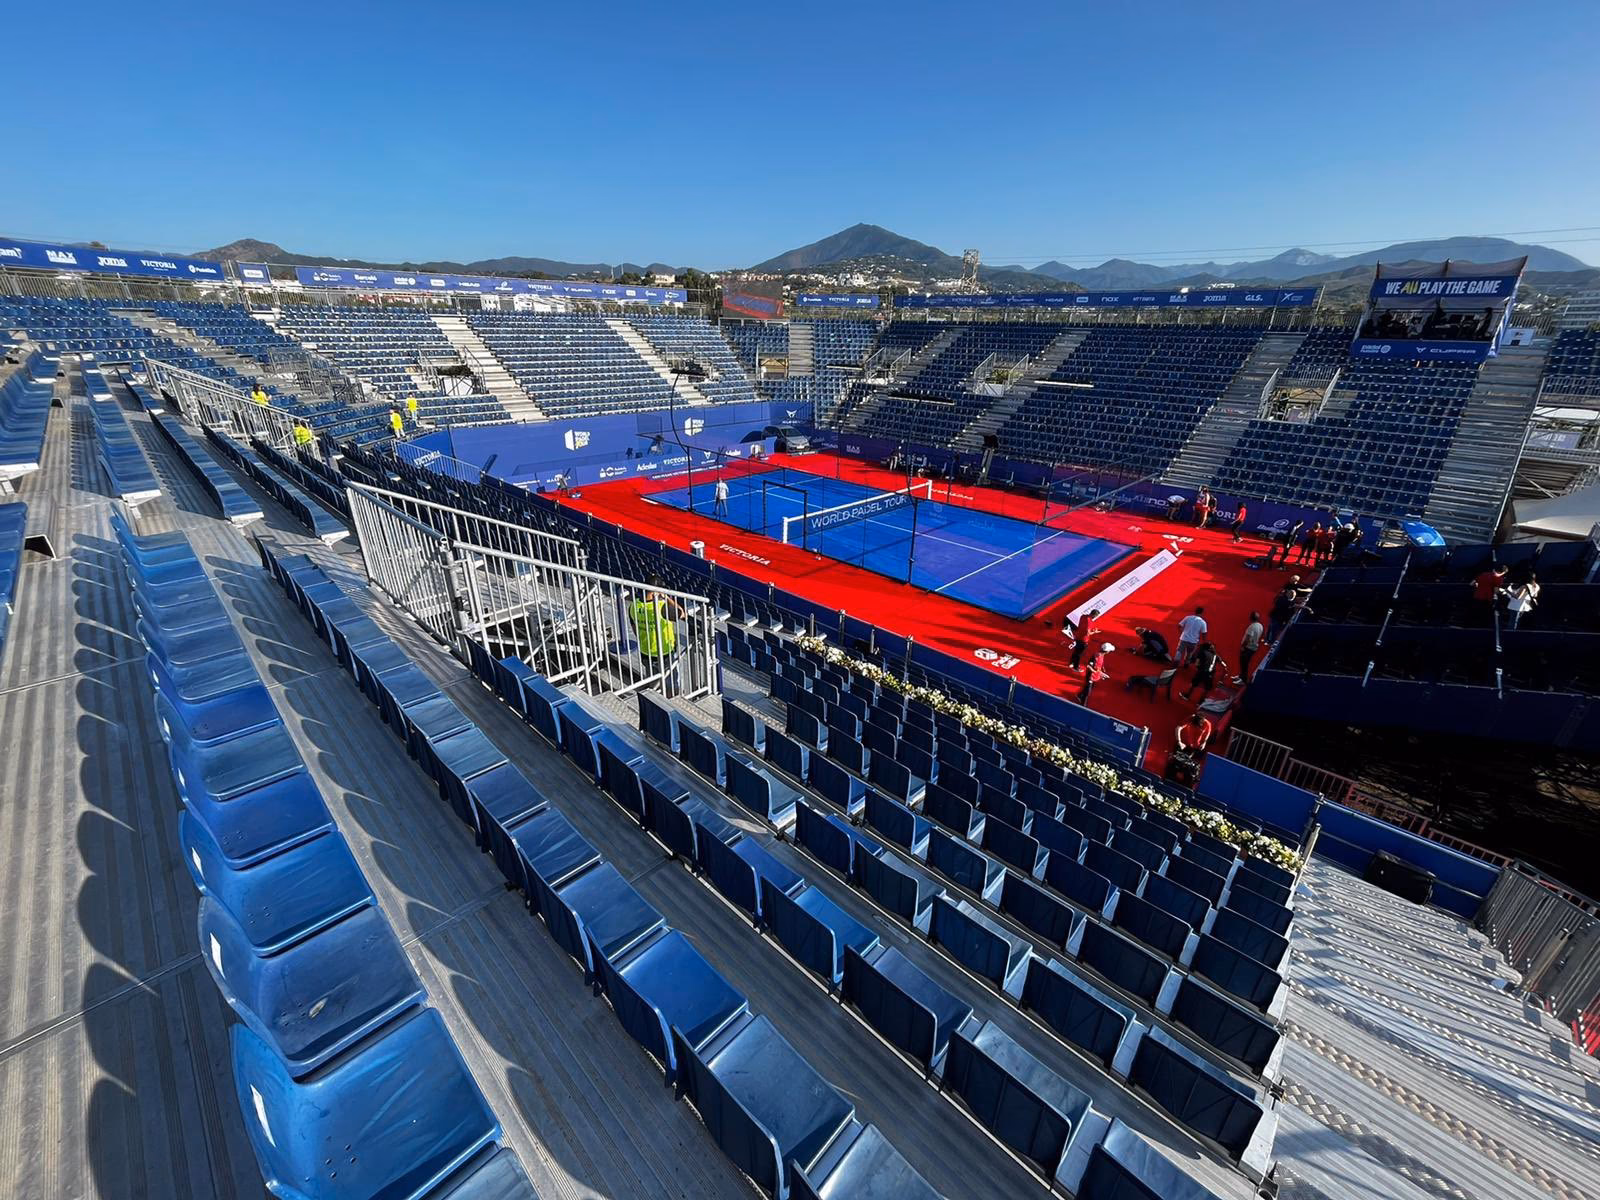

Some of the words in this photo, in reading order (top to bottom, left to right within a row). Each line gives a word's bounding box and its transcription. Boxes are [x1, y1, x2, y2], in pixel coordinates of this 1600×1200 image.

[140, 259, 177, 269] VICTORIA
[1385, 281, 1402, 295] WE
[1418, 281, 1447, 294] PLAY
[1445, 281, 1468, 294] THE
[1466, 280, 1501, 294] GAME
[812, 510, 850, 529] WORLD
[850, 502, 882, 518] PADEL
[883, 495, 907, 509] TOUR
[719, 543, 771, 566] VICTORIA
